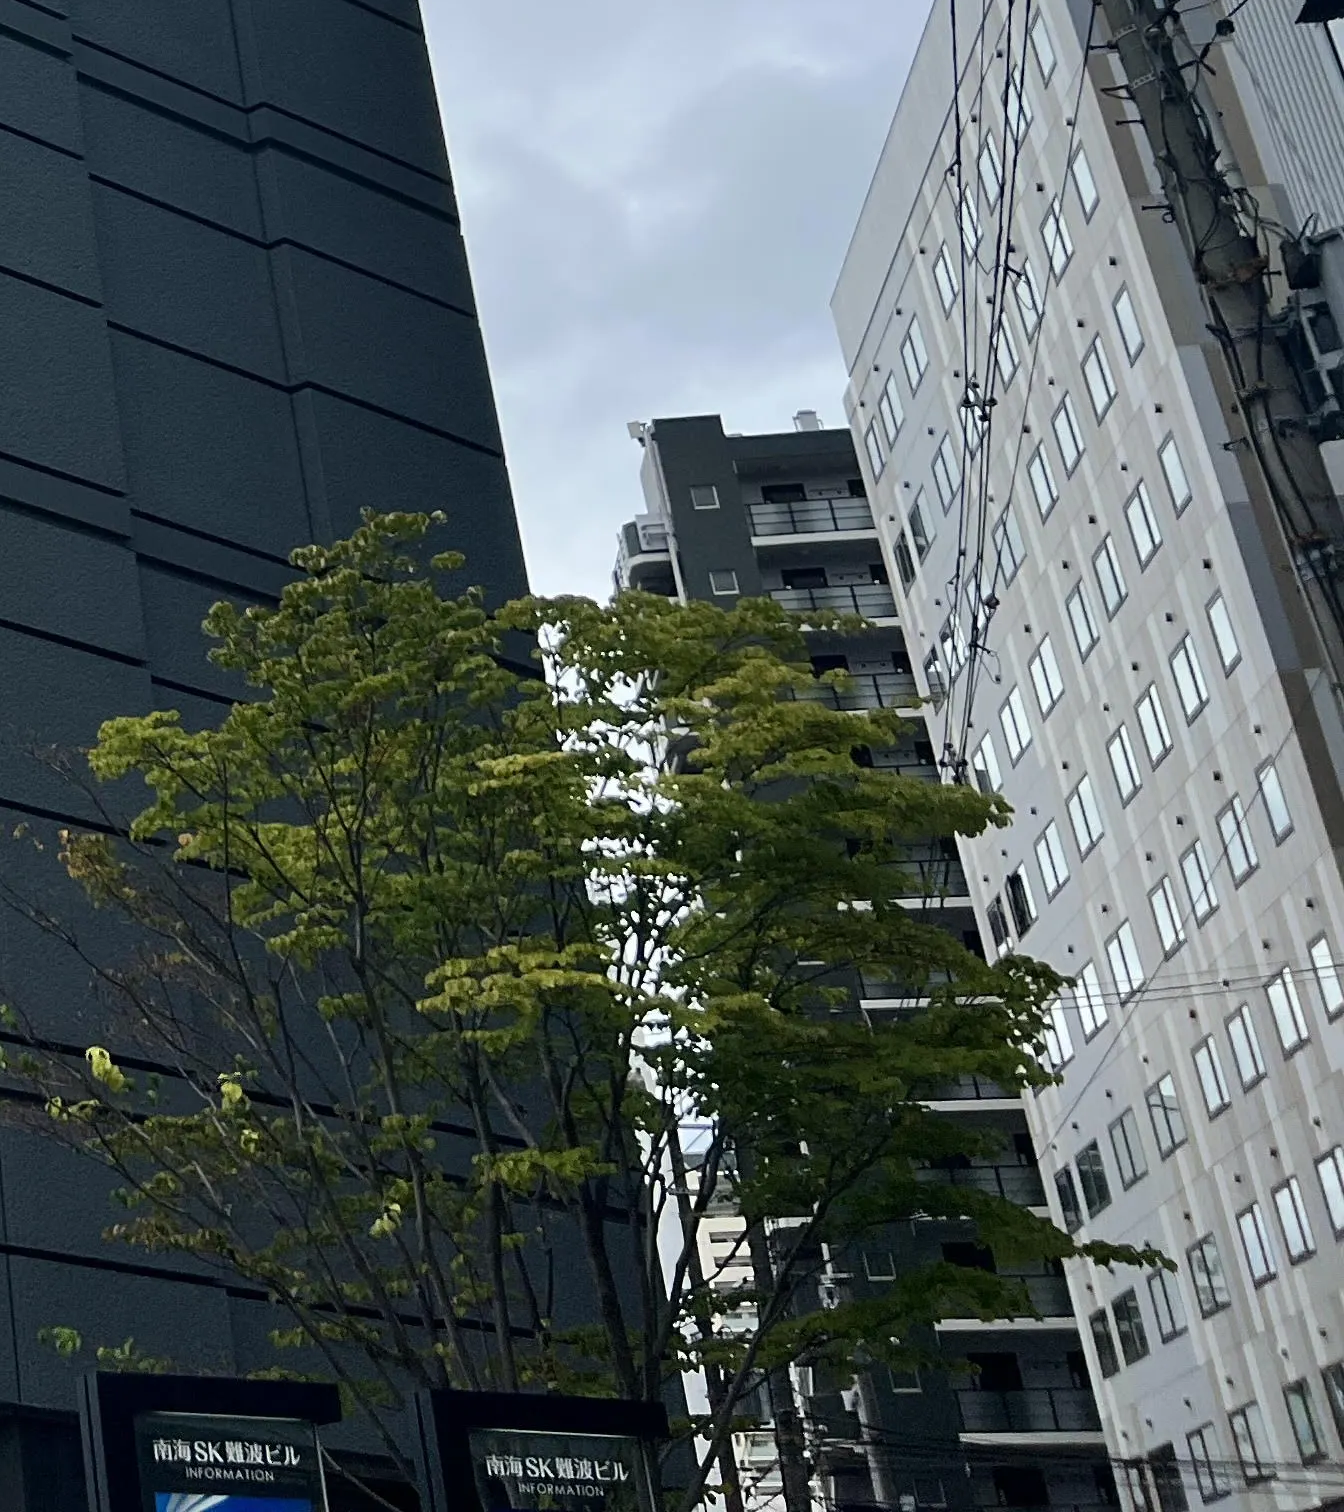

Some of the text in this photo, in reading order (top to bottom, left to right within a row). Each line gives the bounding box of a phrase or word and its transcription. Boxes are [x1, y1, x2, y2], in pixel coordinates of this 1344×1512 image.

[153, 1438, 301, 1466] 南海SK難波ビル
[185, 1466, 275, 1482] INFORMATION
[485, 1454, 629, 1481] 南海SK難波ビル
[517, 1481, 605, 1497] INFORMATION
